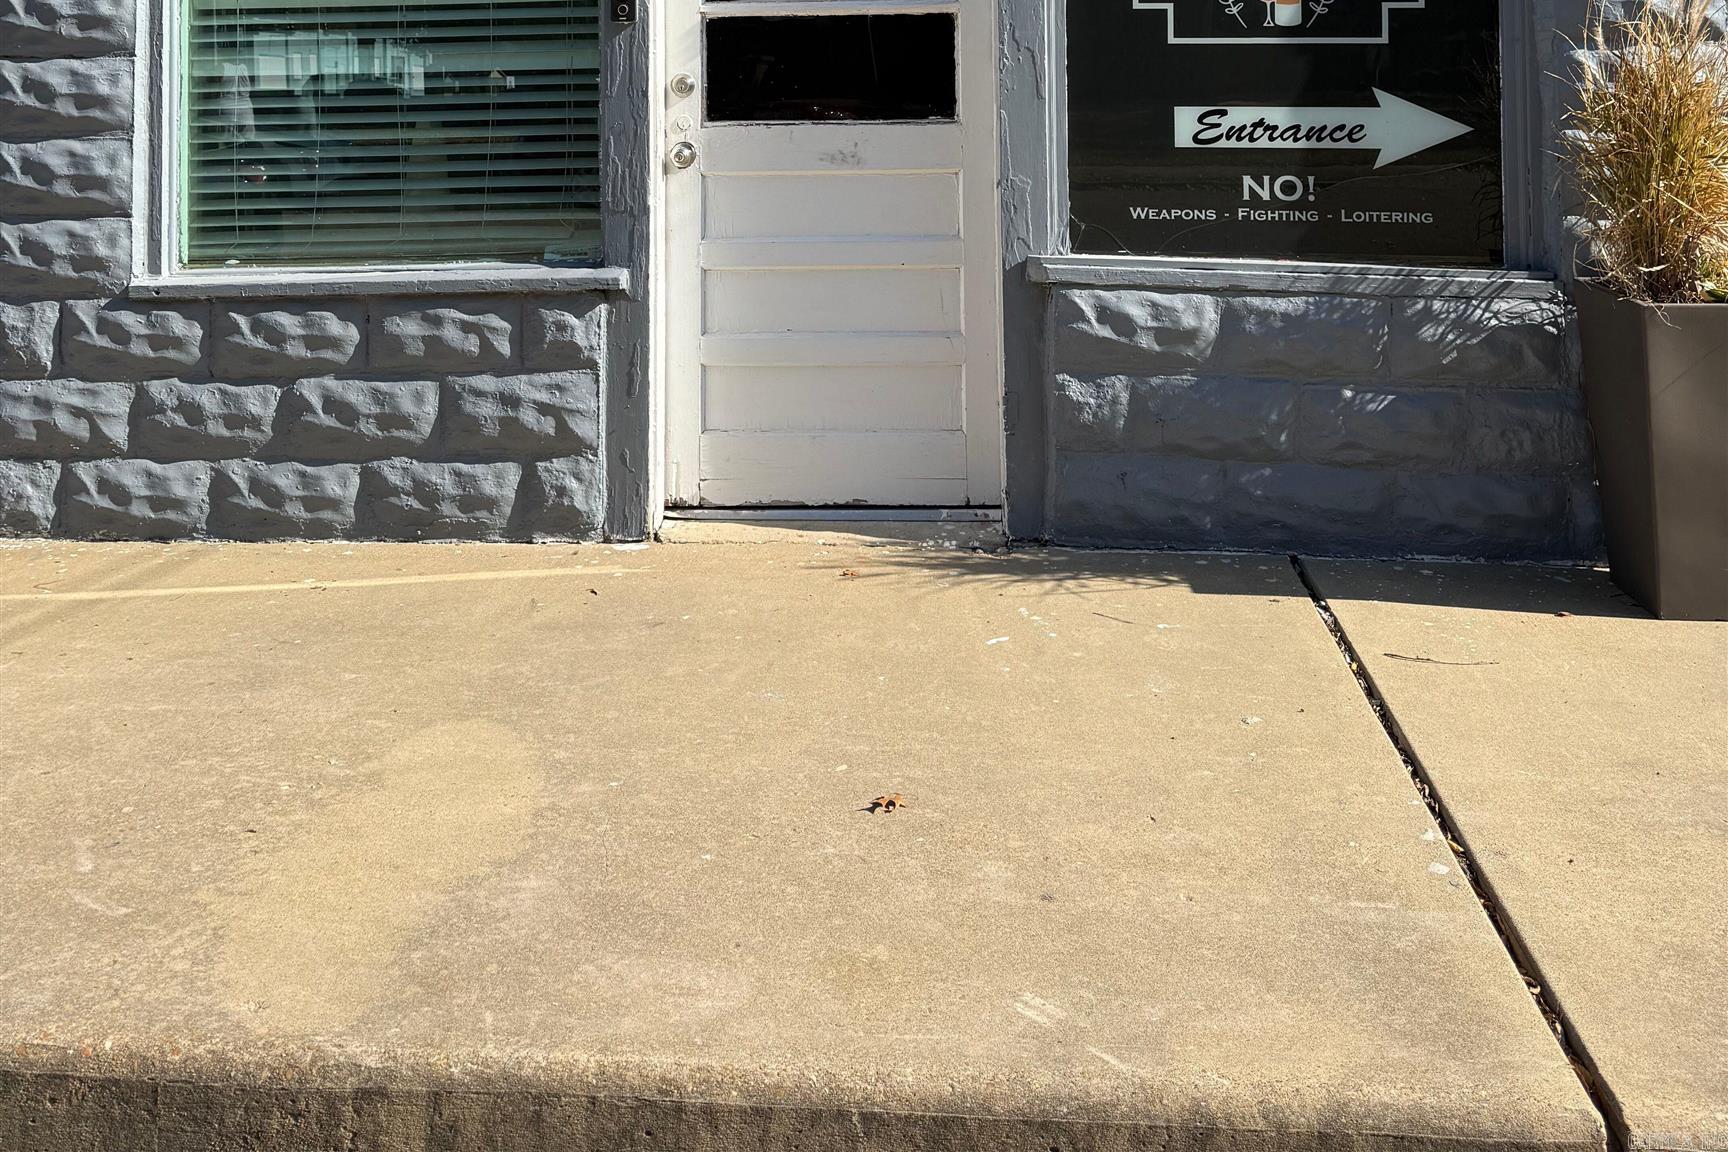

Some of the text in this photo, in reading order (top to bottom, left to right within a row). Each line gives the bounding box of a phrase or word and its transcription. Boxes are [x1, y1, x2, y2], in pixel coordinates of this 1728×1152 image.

[1191, 108, 1368, 146] Entrance
[1241, 175, 1316, 202] NO!
[1129, 206, 1217, 221] WEAPONS
[1238, 207, 1319, 222] FIGHTING
[1340, 209, 1434, 224] LOITERING
